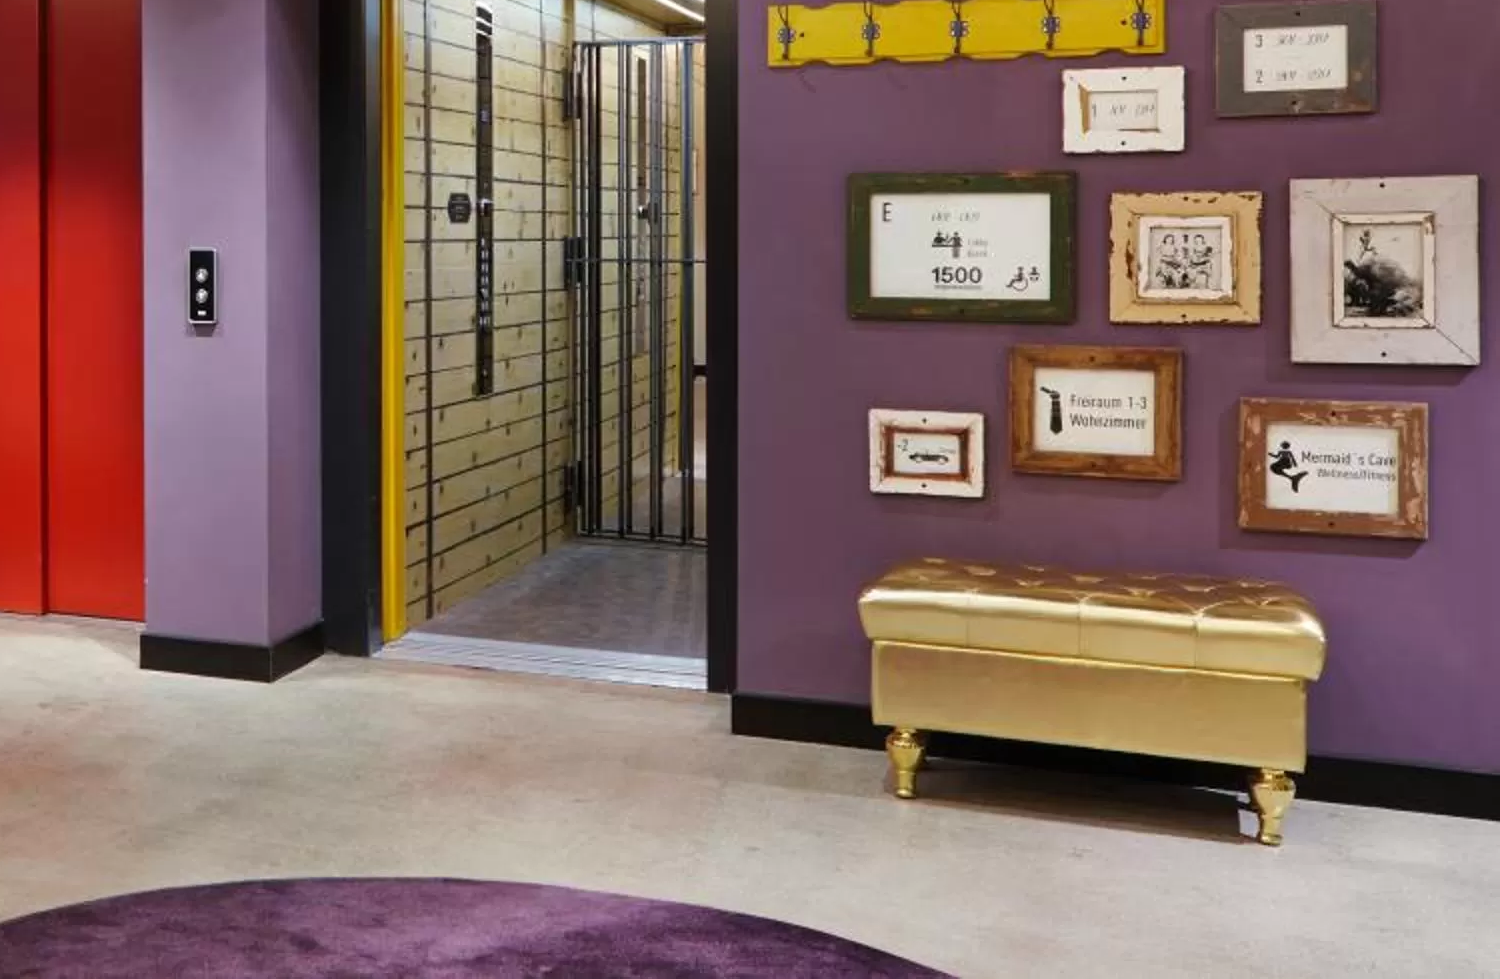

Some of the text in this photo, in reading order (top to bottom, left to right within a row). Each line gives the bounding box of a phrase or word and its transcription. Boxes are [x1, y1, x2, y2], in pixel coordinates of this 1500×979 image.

[1255, 34, 1263, 48] 3
[1255, 69, 1263, 84] 2
[882, 202, 893, 222] E
[931, 266, 983, 284] 1500
[1070, 394, 1148, 410] Freiraum 1-3
[1069, 413, 1146, 430] Wohnzimmer
[1367, 453, 1397, 467] Cave
